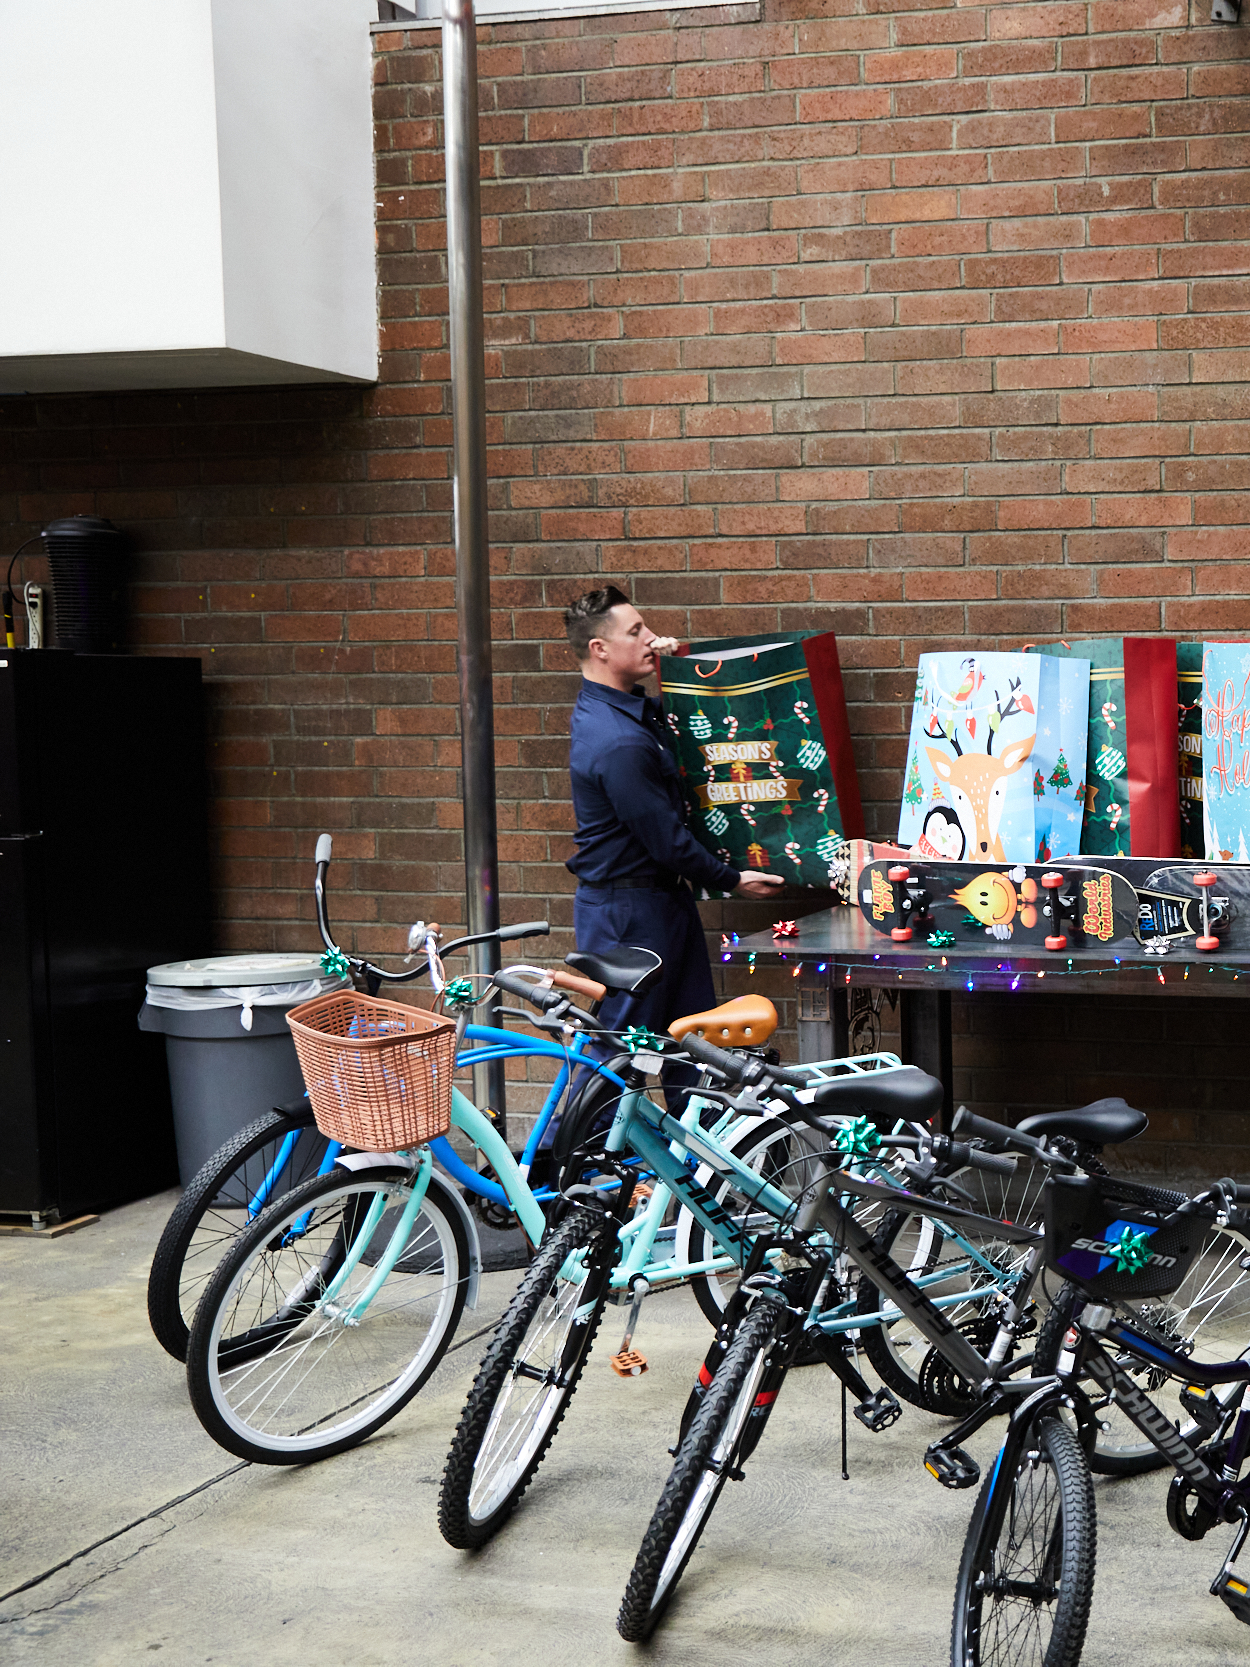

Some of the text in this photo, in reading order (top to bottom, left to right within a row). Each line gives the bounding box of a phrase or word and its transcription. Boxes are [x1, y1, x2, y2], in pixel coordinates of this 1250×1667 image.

[705, 742, 771, 762] SEASON'S
[871, 869, 884, 921] FLAME
[882, 880, 895, 913] BOY
[1083, 880, 1100, 935] World
[1098, 873, 1114, 941] Industries
[674, 1173, 774, 1273] HUFF
[1071, 1237, 1177, 1268] SCNN
[858, 1239, 955, 1337] HUFFY
[1086, 1355, 1210, 1481] SCHWINN
